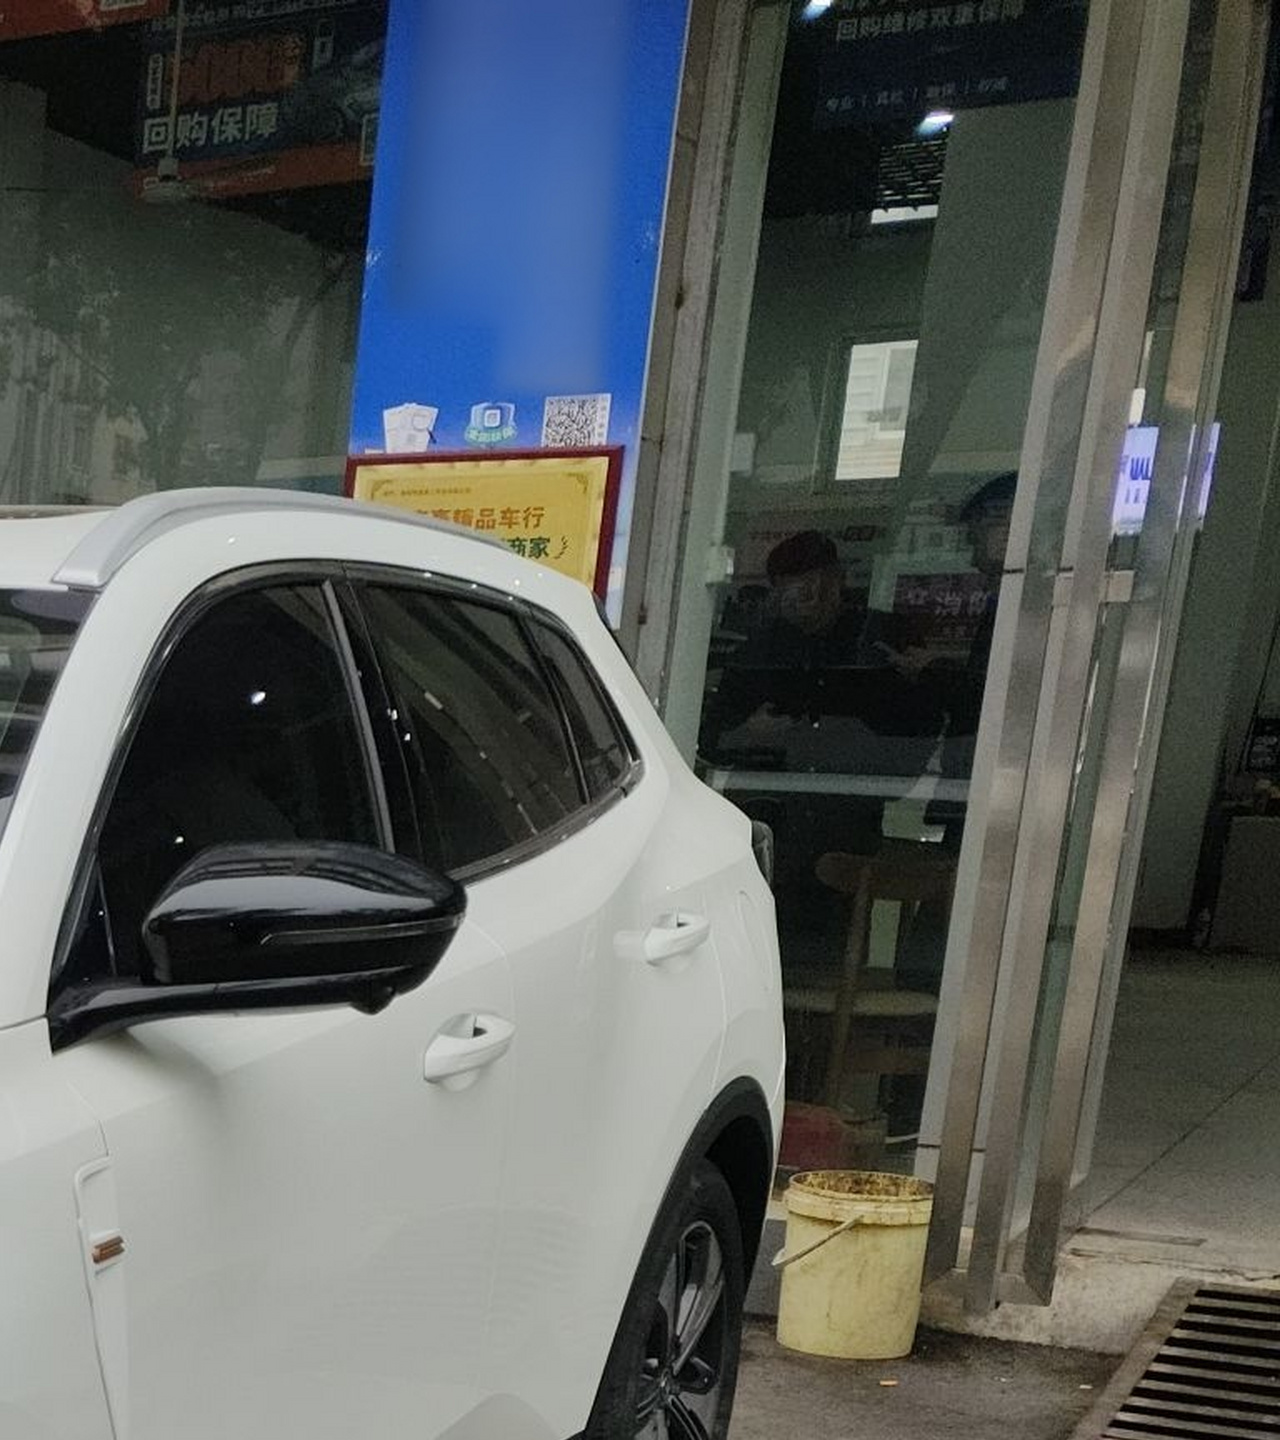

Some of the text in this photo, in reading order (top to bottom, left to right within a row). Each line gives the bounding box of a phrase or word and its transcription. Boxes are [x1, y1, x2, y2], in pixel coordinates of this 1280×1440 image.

[142, 102, 279, 154] 回购保障
[416, 507, 545, 530] 精品车行
